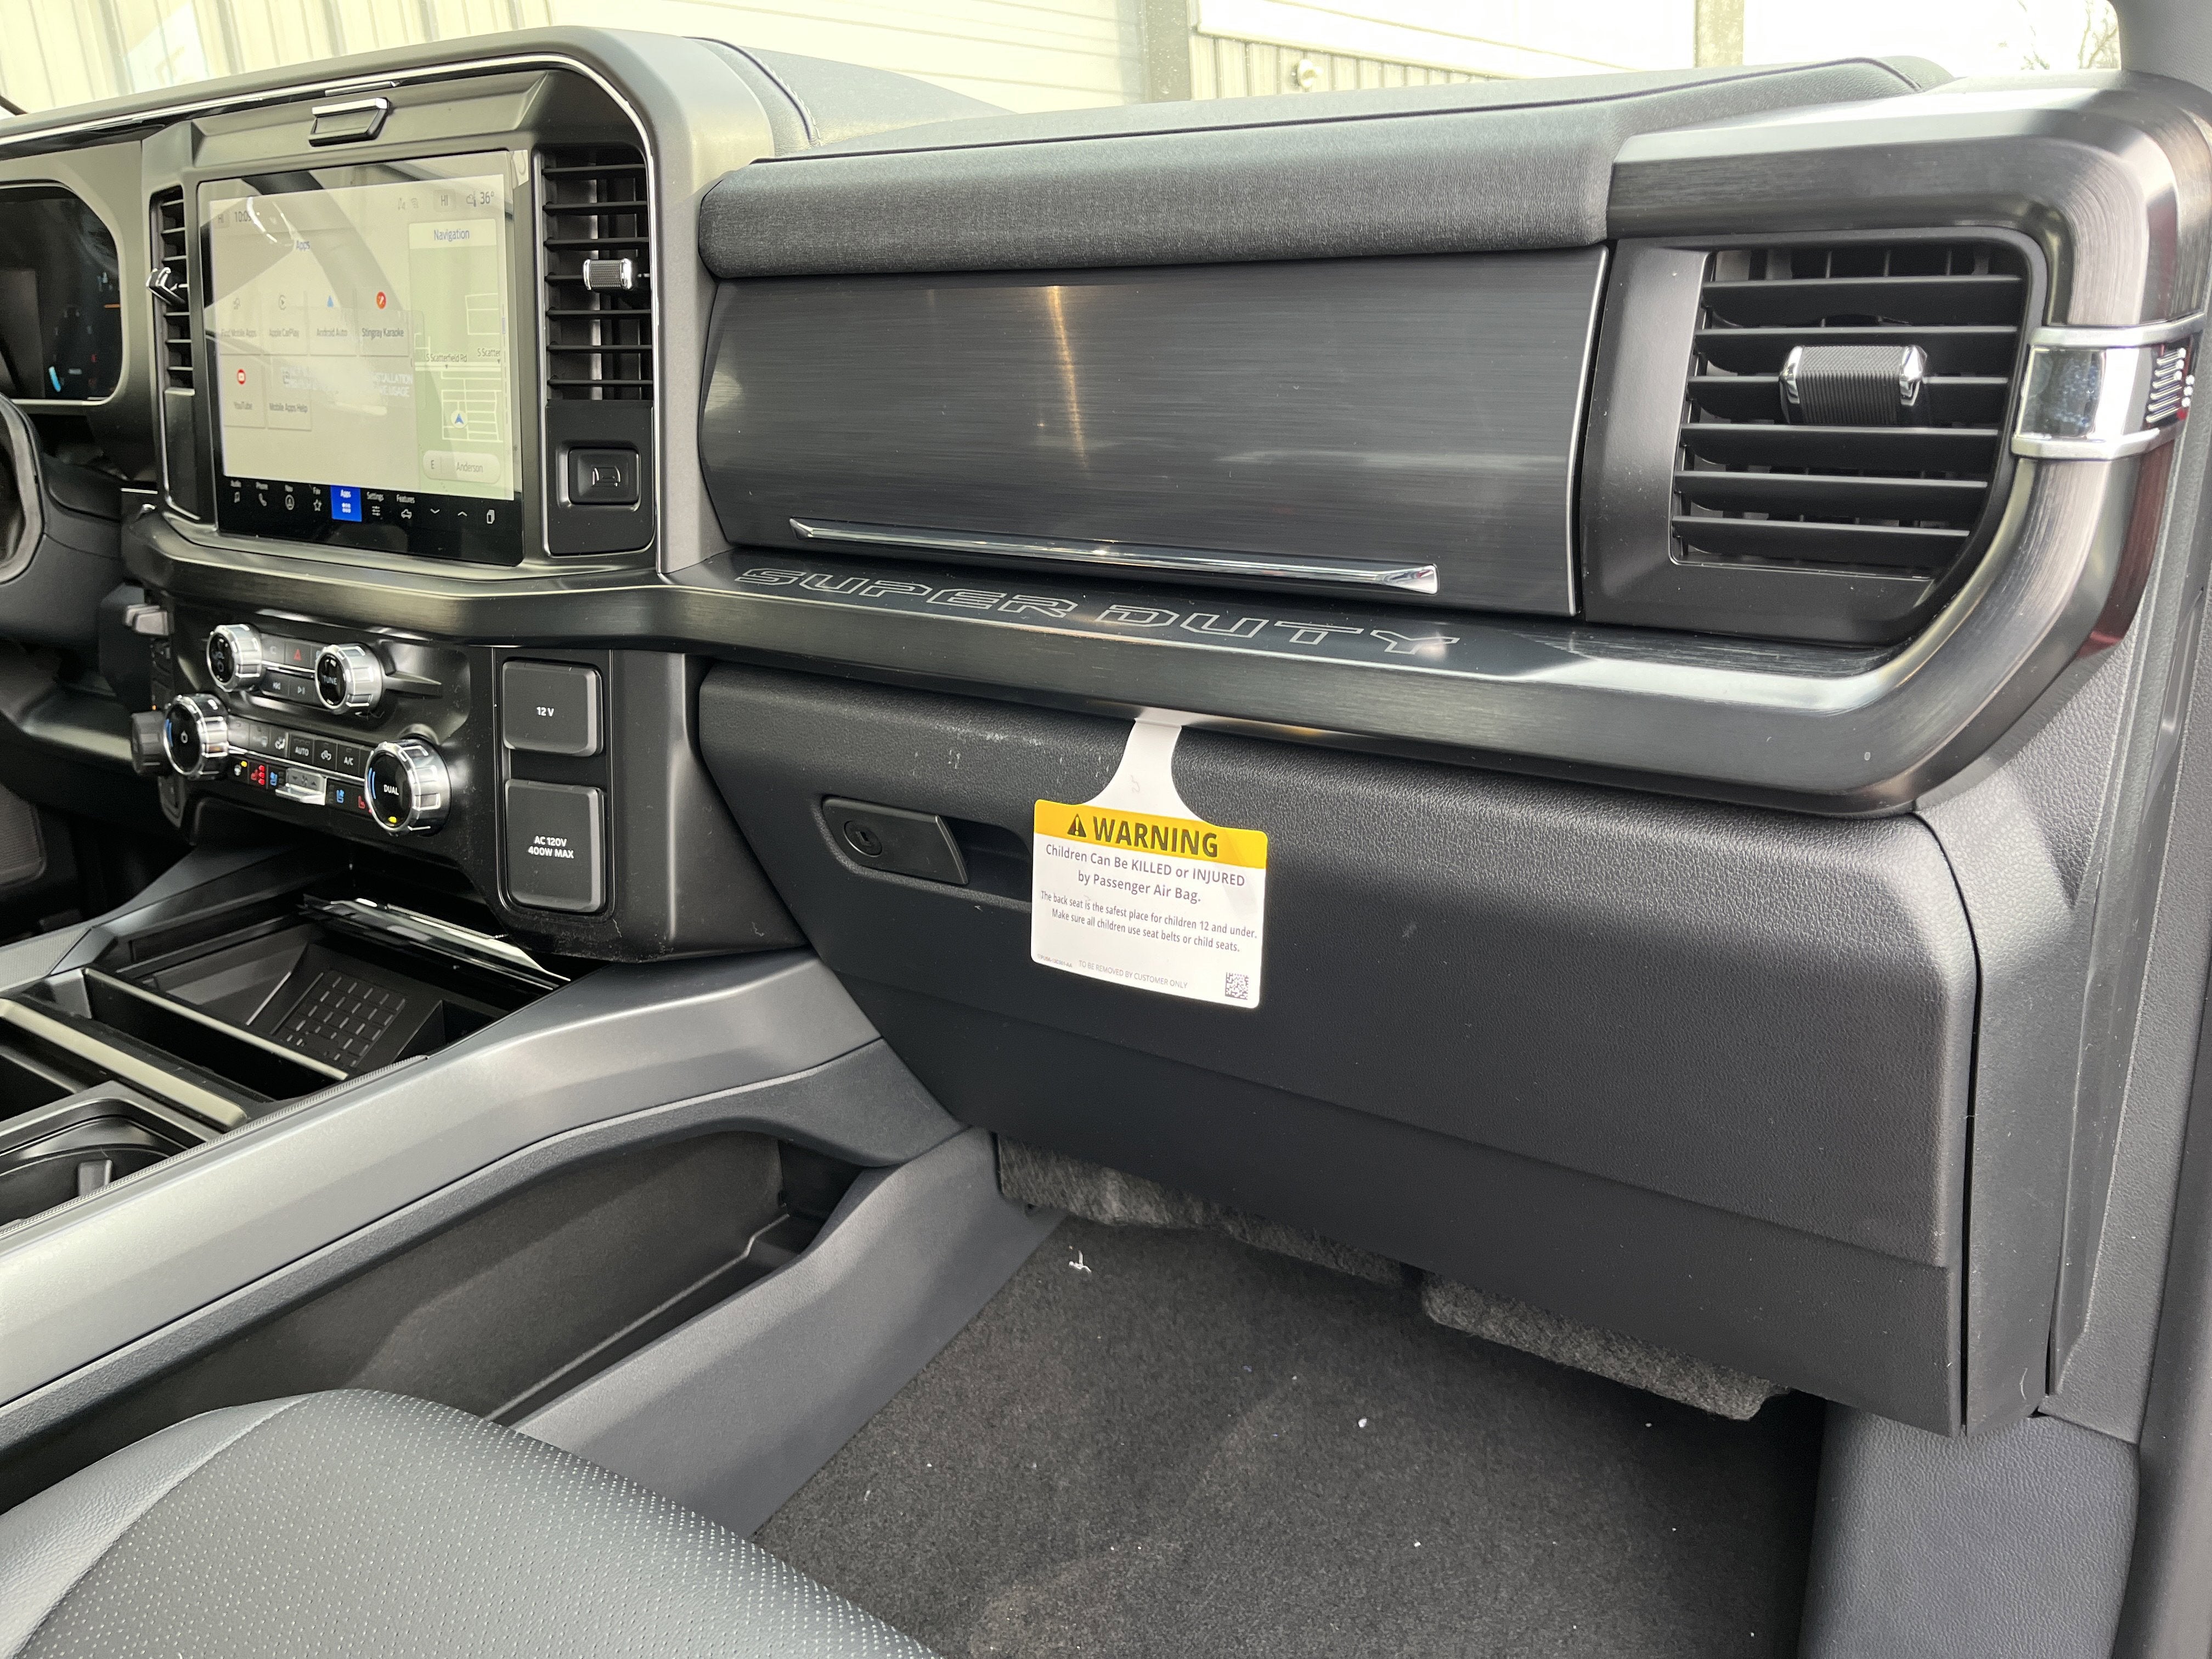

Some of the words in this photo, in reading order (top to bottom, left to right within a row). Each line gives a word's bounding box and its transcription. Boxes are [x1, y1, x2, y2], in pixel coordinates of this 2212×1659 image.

[441, 195, 449, 206] HI
[434, 229, 470, 241] Navigation
[296, 240, 310, 251] Apps
[362, 328, 382, 340] Stingray
[383, 328, 404, 337] Karaoke
[431, 353, 460, 362] Scatterfield
[460, 354, 467, 362] Rd
[431, 460, 435, 469] E
[456, 462, 483, 472] Anderson
[735, 568, 1078, 618] SUPER
[1094, 604, 1460, 654] DUTY
[321, 674, 337, 685] TUNE
[537, 707, 546, 716] 12
[548, 707, 554, 716] V
[295, 746, 309, 757] AUTO
[343, 756, 354, 766] A/C
[383, 784, 399, 795] DUAL
[534, 836, 546, 845] AC
[546, 837, 567, 847] 120V
[1093, 816, 1218, 857] WARNING
[528, 846, 553, 856] 400W
[554, 848, 574, 859] MAX
[1046, 844, 1087, 862] Children
[1091, 853, 1110, 866] Can
[1114, 856, 1128, 869] Be
[1131, 859, 1172, 876] KILLED
[1176, 868, 1189, 878] or
[1193, 868, 1245, 887] INJURED
[1078, 870, 1090, 885] by
[1093, 874, 1150, 895] Passenger
[1153, 884, 1171, 897] Air
[1175, 888, 1201, 904] Bag.
[1041, 890, 1052, 901] The
[1053, 893, 1068, 905] back
[1069, 898, 1084, 909] seat
[1085, 900, 1091, 910] is
[1092, 902, 1104, 913] the
[1105, 905, 1127, 917] safest
[1128, 909, 1149, 921] place
[1151, 912, 1162, 923] for
[1164, 915, 1197, 929] children
[1199, 921, 1209, 931] 12
[1211, 923, 1227, 934] and
[1230, 926, 1257, 939] under.
[1052, 908, 1069, 920] Make
[1071, 914, 1085, 924] sure
[1087, 916, 1095, 927] all
[1097, 918, 1126, 933] children
[1128, 926, 1141, 935] use
[1143, 929, 1159, 939] seat
[1161, 930, 1180, 943] belts
[1183, 935, 1192, 944] or
[1194, 936, 1214, 947] child
[1216, 940, 1240, 952] seats.
[1079, 960, 1086, 968] TO
[1096, 964, 1124, 977] REMOVED
[1125, 970, 1133, 978] BY
[1134, 973, 1169, 986] CUSTOMER
[1170, 979, 1188, 989] ONLY
